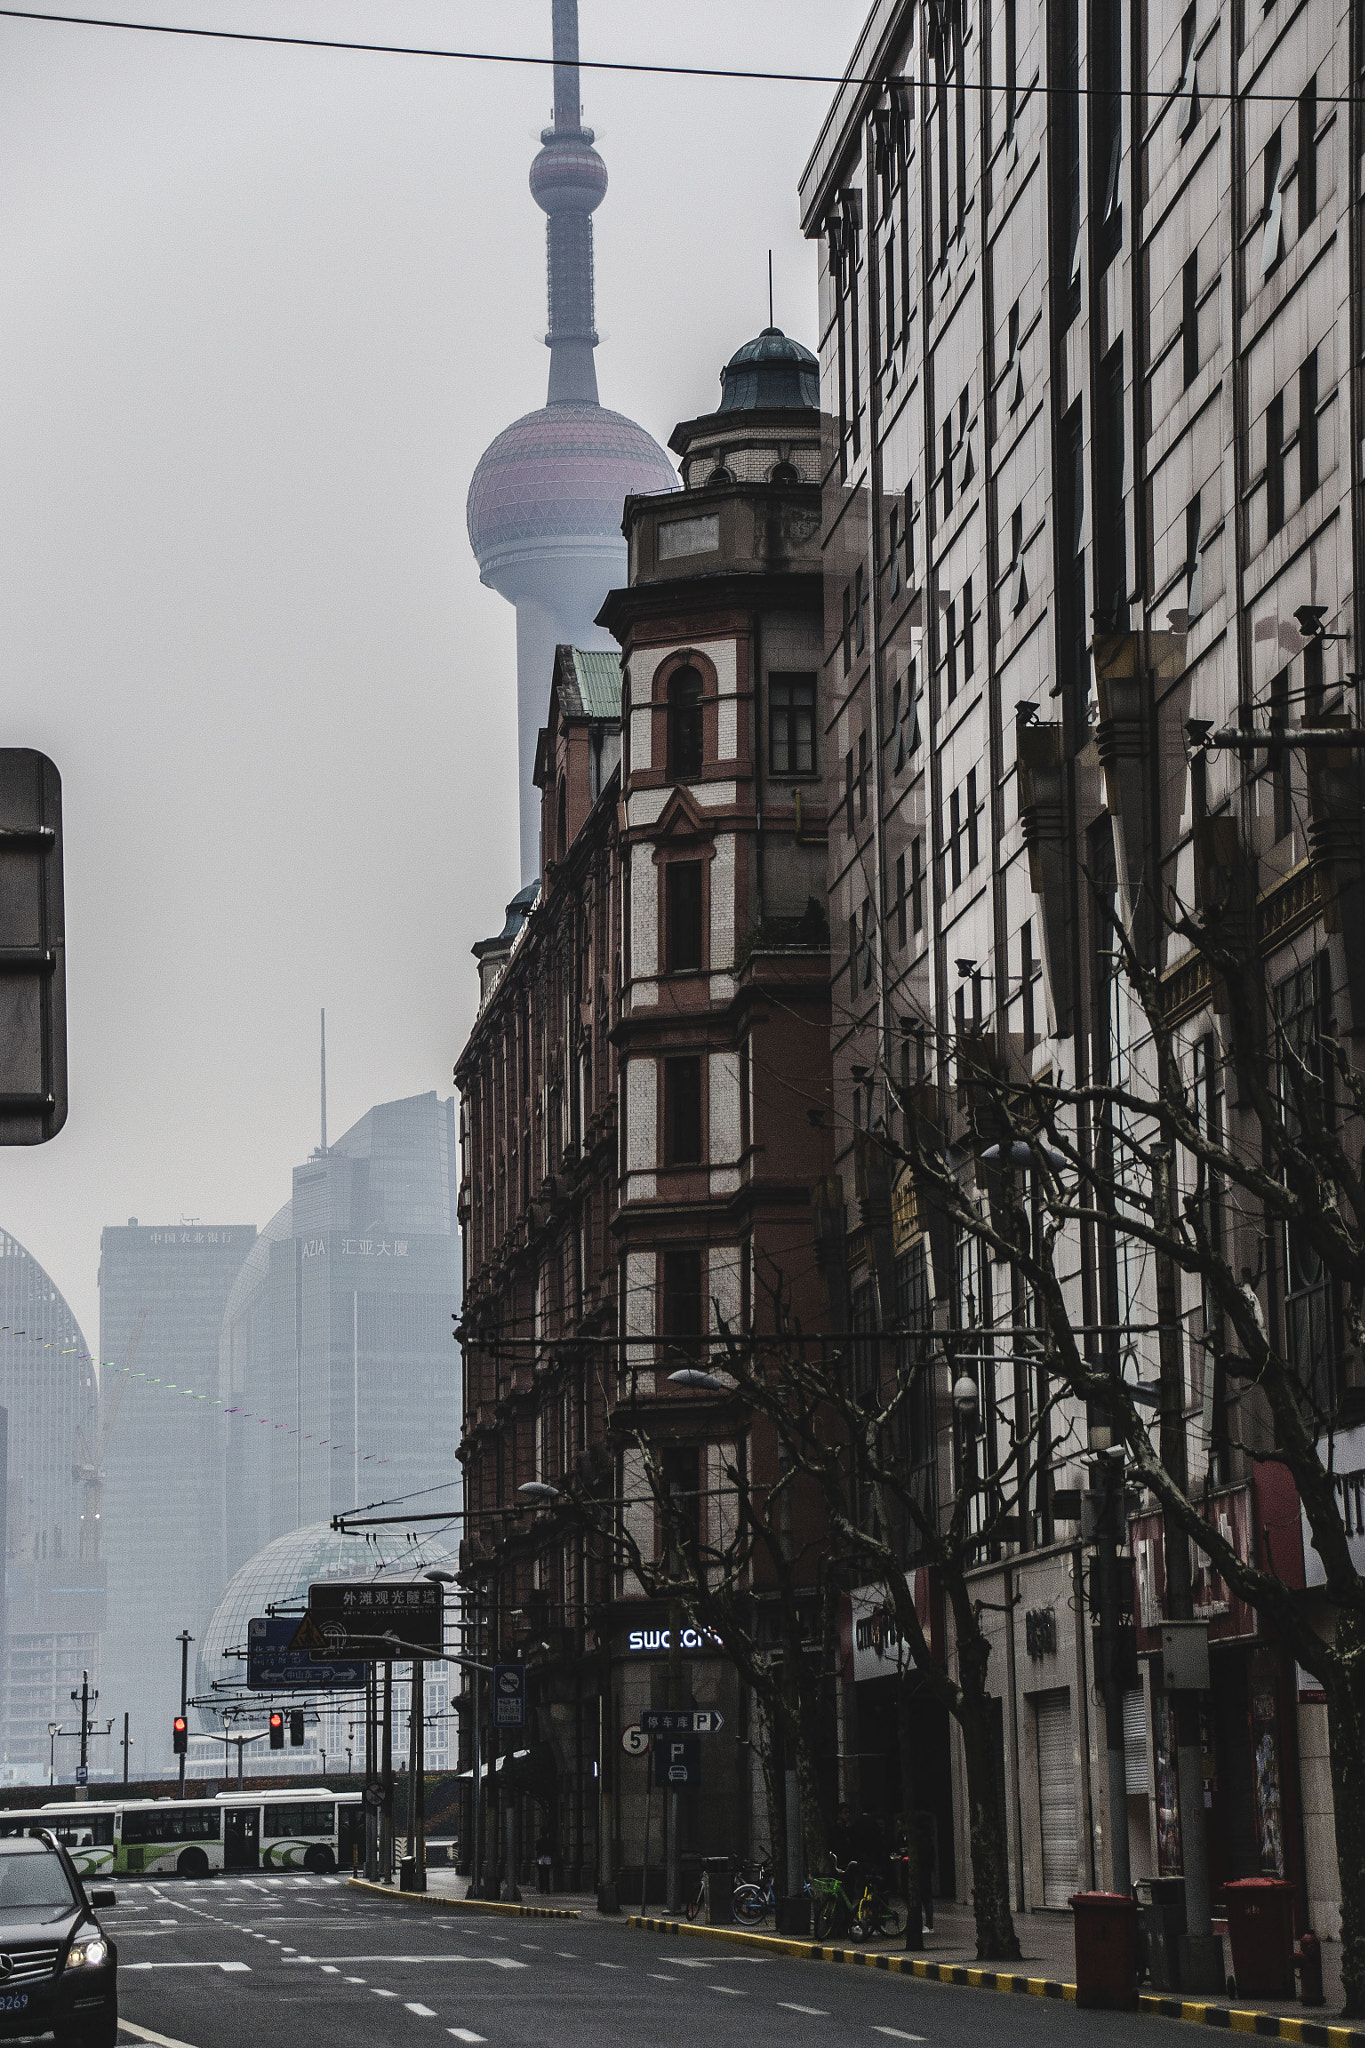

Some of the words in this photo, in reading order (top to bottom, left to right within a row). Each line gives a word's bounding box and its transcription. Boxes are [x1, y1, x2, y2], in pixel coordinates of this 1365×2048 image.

[150, 1232, 234, 1245] 中国农业银行
[302, 1241, 326, 1259] AZIA
[341, 1239, 410, 1258] 汇亚大厦
[343, 1589, 437, 1606] 外滩观光隧道
[648, 1715, 689, 1729] 停车库
[630, 1731, 641, 1749] 5
[671, 1744, 684, 1762] P
